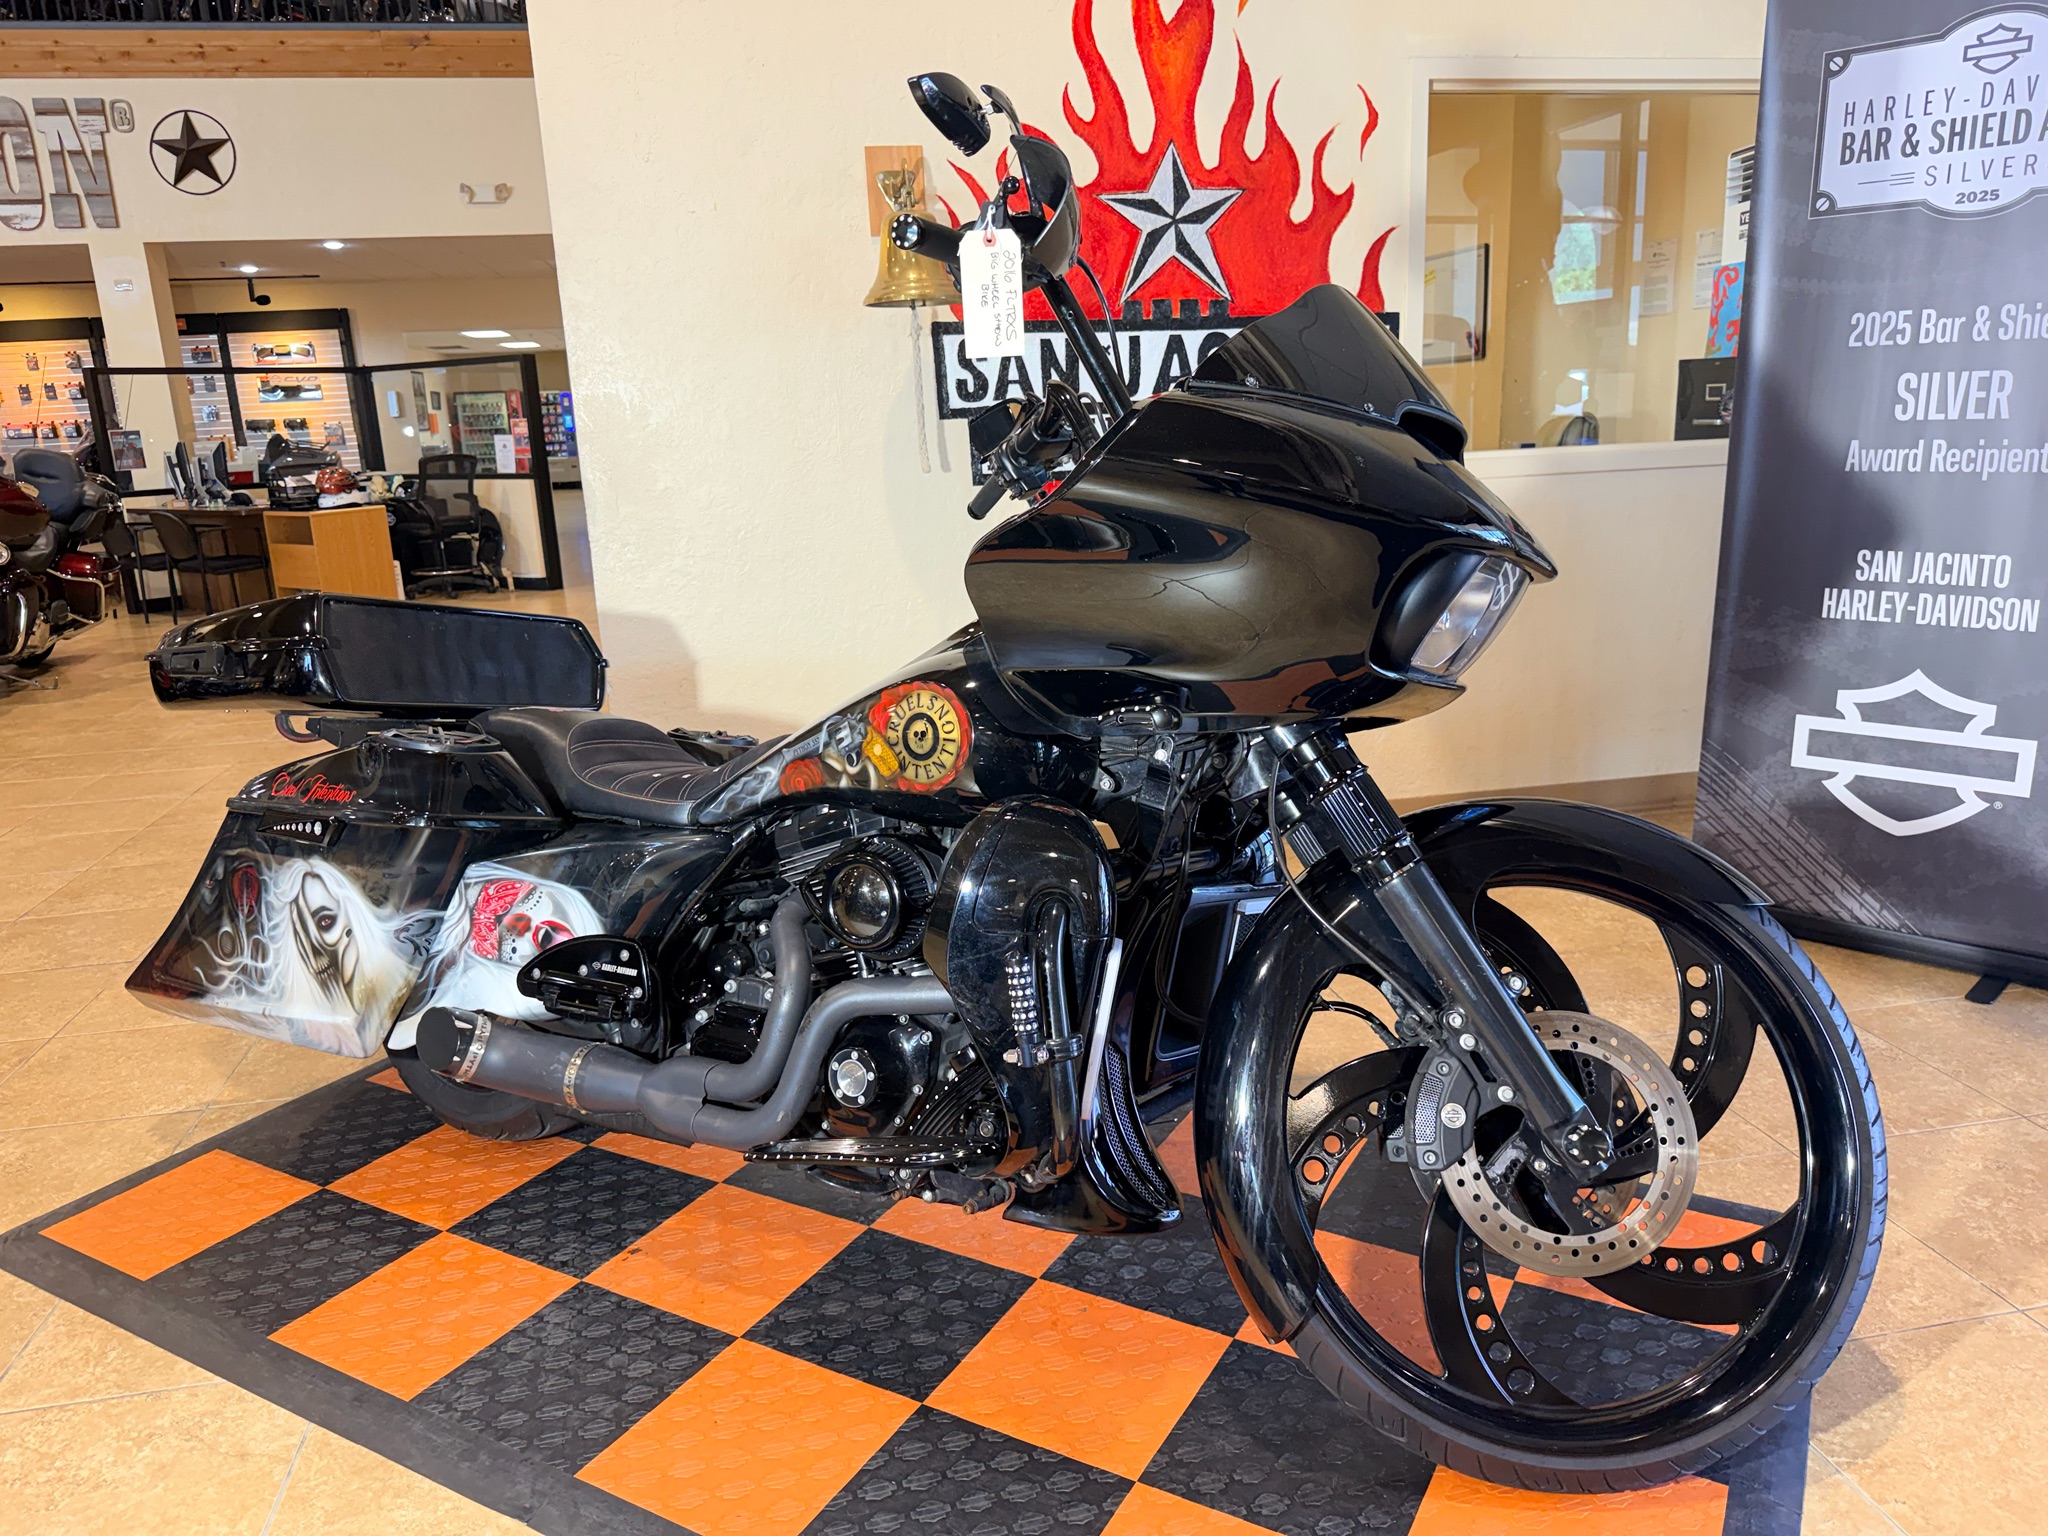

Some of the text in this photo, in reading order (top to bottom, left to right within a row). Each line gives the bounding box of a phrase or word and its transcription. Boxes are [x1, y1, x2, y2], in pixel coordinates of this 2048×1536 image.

[1839, 126, 1892, 165] BAR
[1900, 122, 1920, 158] &
[1928, 108, 2033, 154] SHIELD
[1924, 154, 2038, 187] SILVER
[1955, 189, 2000, 205] 2025
[981, 283, 990, 308] BIKE
[990, 273, 1000, 309] WHEEL
[1002, 250, 1018, 341] 2016 FLTRXS
[1848, 309, 1913, 347] 2025
[1918, 308, 1967, 344] Bar
[1972, 305, 1992, 342] &
[1894, 370, 2014, 421] SILVER
[1844, 439, 1925, 472] Award
[1855, 549, 2012, 588] SAN JACINTO
[1821, 587, 2040, 632] HARLEY-DAVIDSON
[301, 773, 357, 804] Intentions
